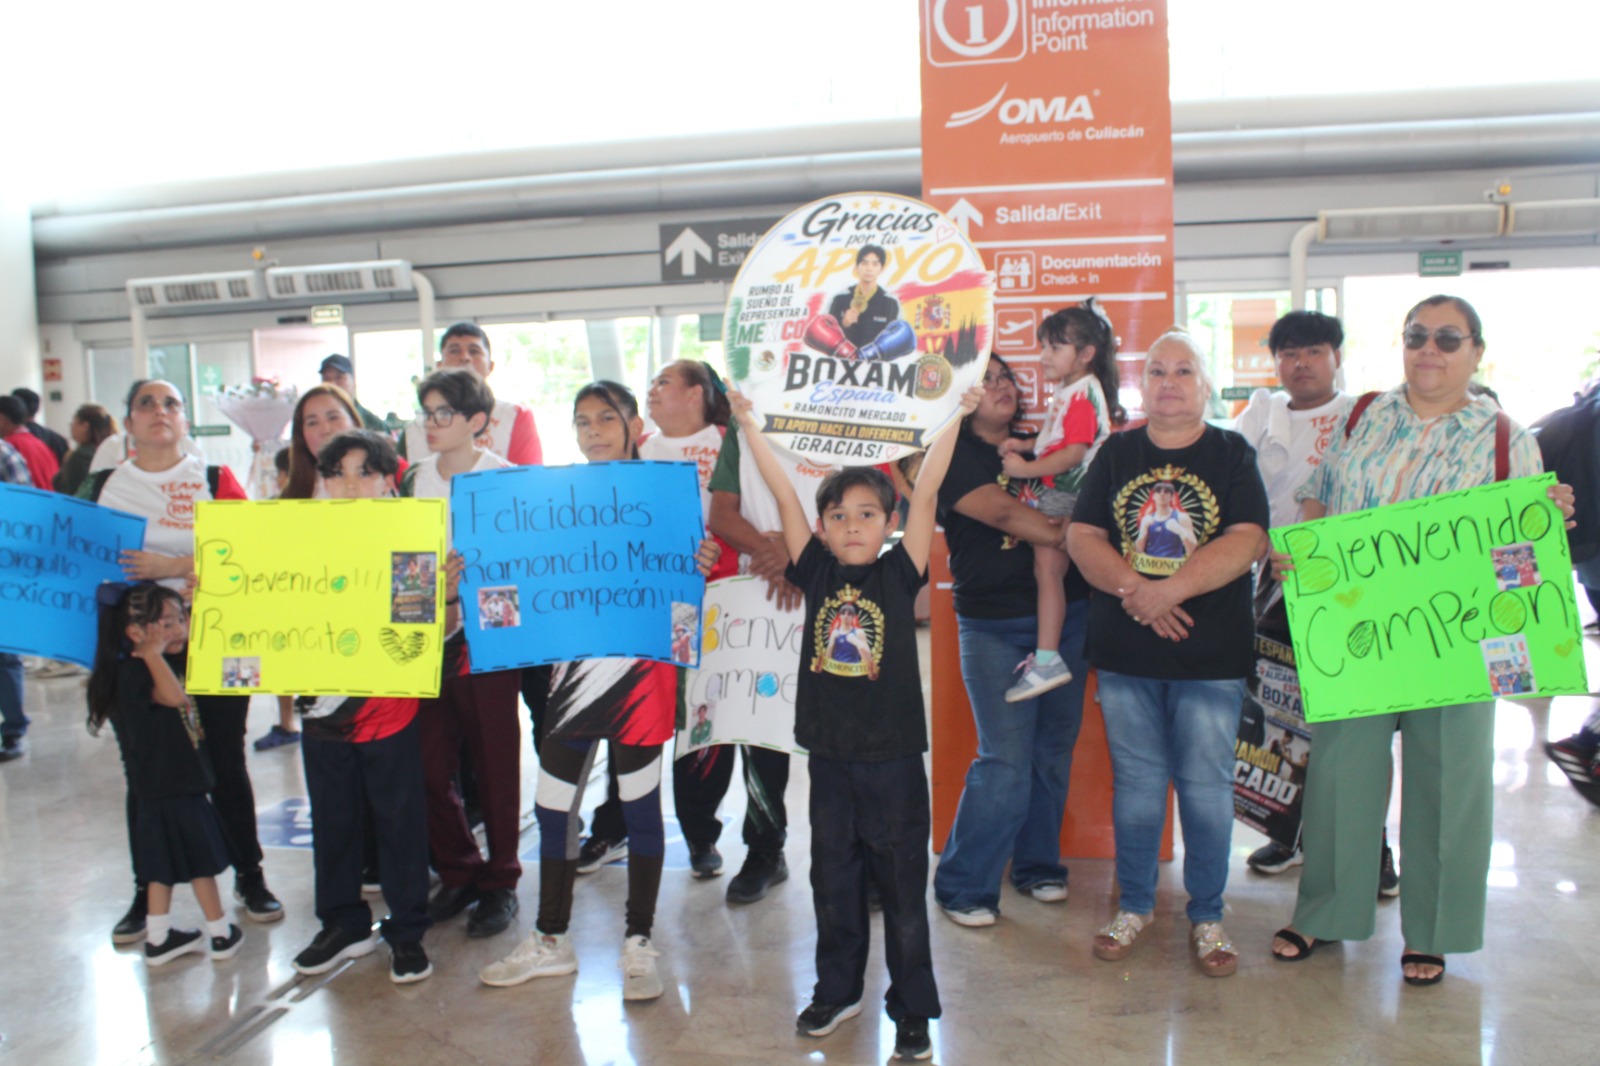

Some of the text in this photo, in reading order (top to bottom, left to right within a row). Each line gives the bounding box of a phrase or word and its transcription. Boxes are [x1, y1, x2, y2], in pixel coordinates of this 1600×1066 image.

[1032, 6, 1154, 33] Information
[1032, 31, 1088, 54] Point
[998, 95, 1094, 125] OMA
[1000, 124, 1144, 145] Aeropuerto de Culiacán
[802, 201, 939, 245] Gracias
[995, 202, 1102, 224] Salida/Exit
[717, 232, 757, 249] Salid
[845, 230, 898, 249] por tu
[718, 250, 746, 267] Exit
[1041, 252, 1162, 270] Documentación
[748, 283, 795, 297] RUMBO AL
[1041, 272, 1078, 285] Check
[740, 308, 809, 322] REPRESENTAR A
[746, 296, 793, 310] SUEÑO DE
[784, 353, 916, 399] BOXAM
[809, 381, 898, 405] España
[793, 402, 907, 423] RAMONCITO MERCADO
[772, 417, 915, 443] TU APOYO HACE LA DIFERENCIA
[790, 435, 884, 459] ¡GRACIAS!
[160, 481, 203, 494] TEAM
[464, 484, 653, 535] Felicidades
[52, 512, 122, 565] Mercad
[459, 536, 702, 584] Ramoncito Mercad
[1132, 555, 1182, 571] RAMONCI
[0, 579, 97, 617] exicano
[199, 607, 361, 657] Ramoncito
[701, 602, 804, 656] Bienve
[690, 669, 797, 715] Campe
[1262, 684, 1302, 715] BOXA
[1234, 759, 1298, 806] CADO
